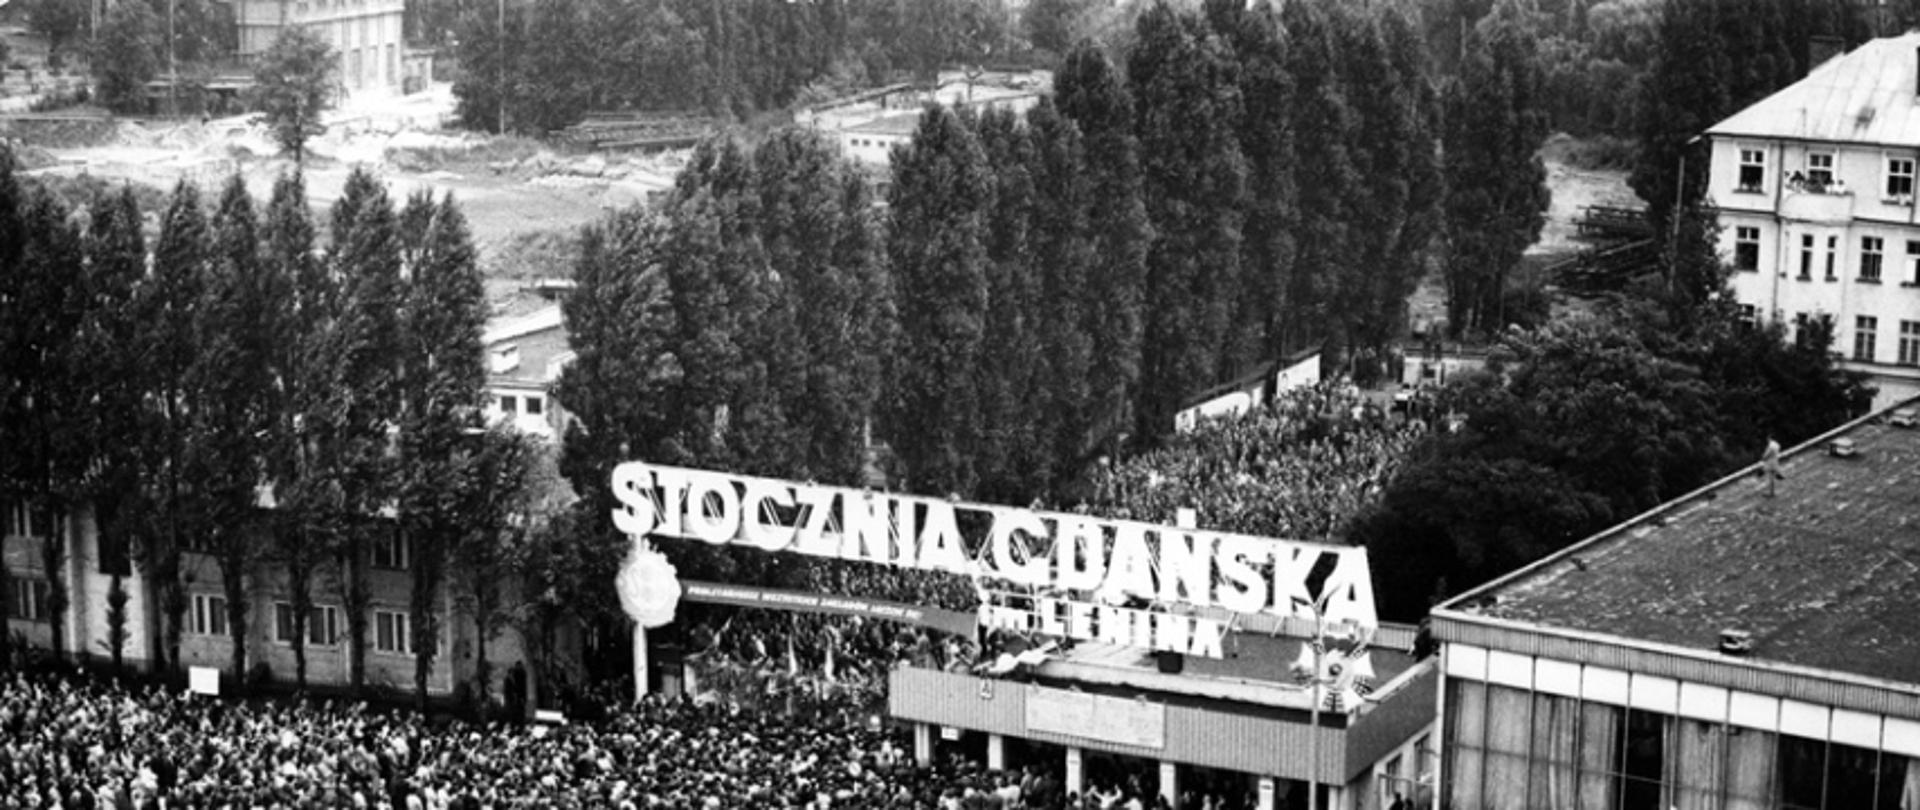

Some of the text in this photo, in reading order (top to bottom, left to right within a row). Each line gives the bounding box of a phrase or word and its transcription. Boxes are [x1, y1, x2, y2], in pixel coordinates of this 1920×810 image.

[611, 462, 1378, 630] STOCZNIA GDAŃSKA
[1042, 597, 1224, 659] LENINA
